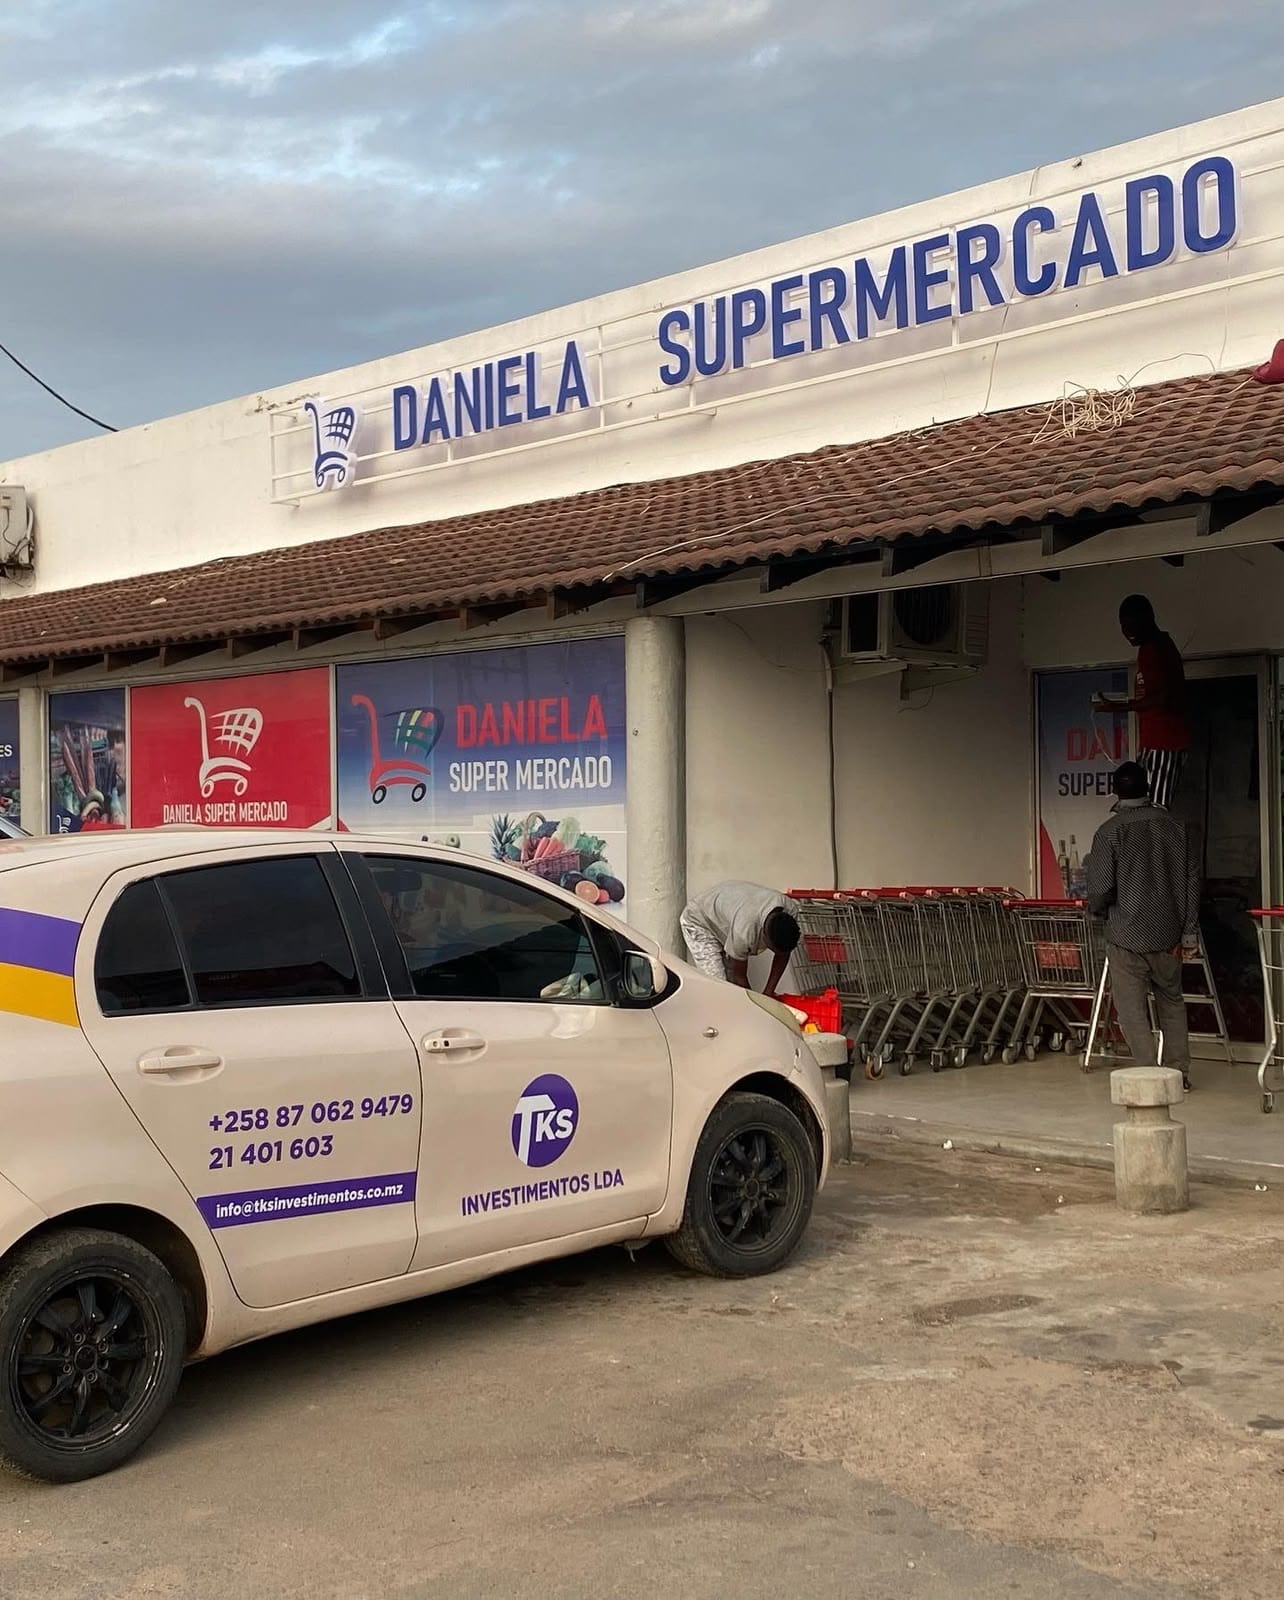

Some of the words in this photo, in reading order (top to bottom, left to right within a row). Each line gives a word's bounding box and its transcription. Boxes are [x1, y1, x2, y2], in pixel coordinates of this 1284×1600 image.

[393, 340, 590, 451] DANIELA
[657, 156, 1237, 386] SUPERMERCADO
[456, 693, 608, 748] DANIELA
[450, 761, 509, 793] SUPER
[515, 755, 612, 790] MERCADO
[163, 803, 202, 824] DANIELA
[205, 803, 236, 823] SUPER
[239, 801, 288, 822] MERCADO
[208, 1108, 270, 1134] +258
[275, 1104, 304, 1129] 87
[310, 1100, 355, 1124] 062
[360, 1093, 414, 1118] 9479
[513, 1094, 574, 1165] TKS
[208, 1146, 235, 1170] 21
[240, 1140, 283, 1165] 401
[288, 1135, 335, 1159] 603
[215, 1184, 404, 1219] info@tksinvestimentos.co.mz
[461, 1174, 591, 1216] INVESTIMENTOS
[594, 1168, 625, 1190] LDA
